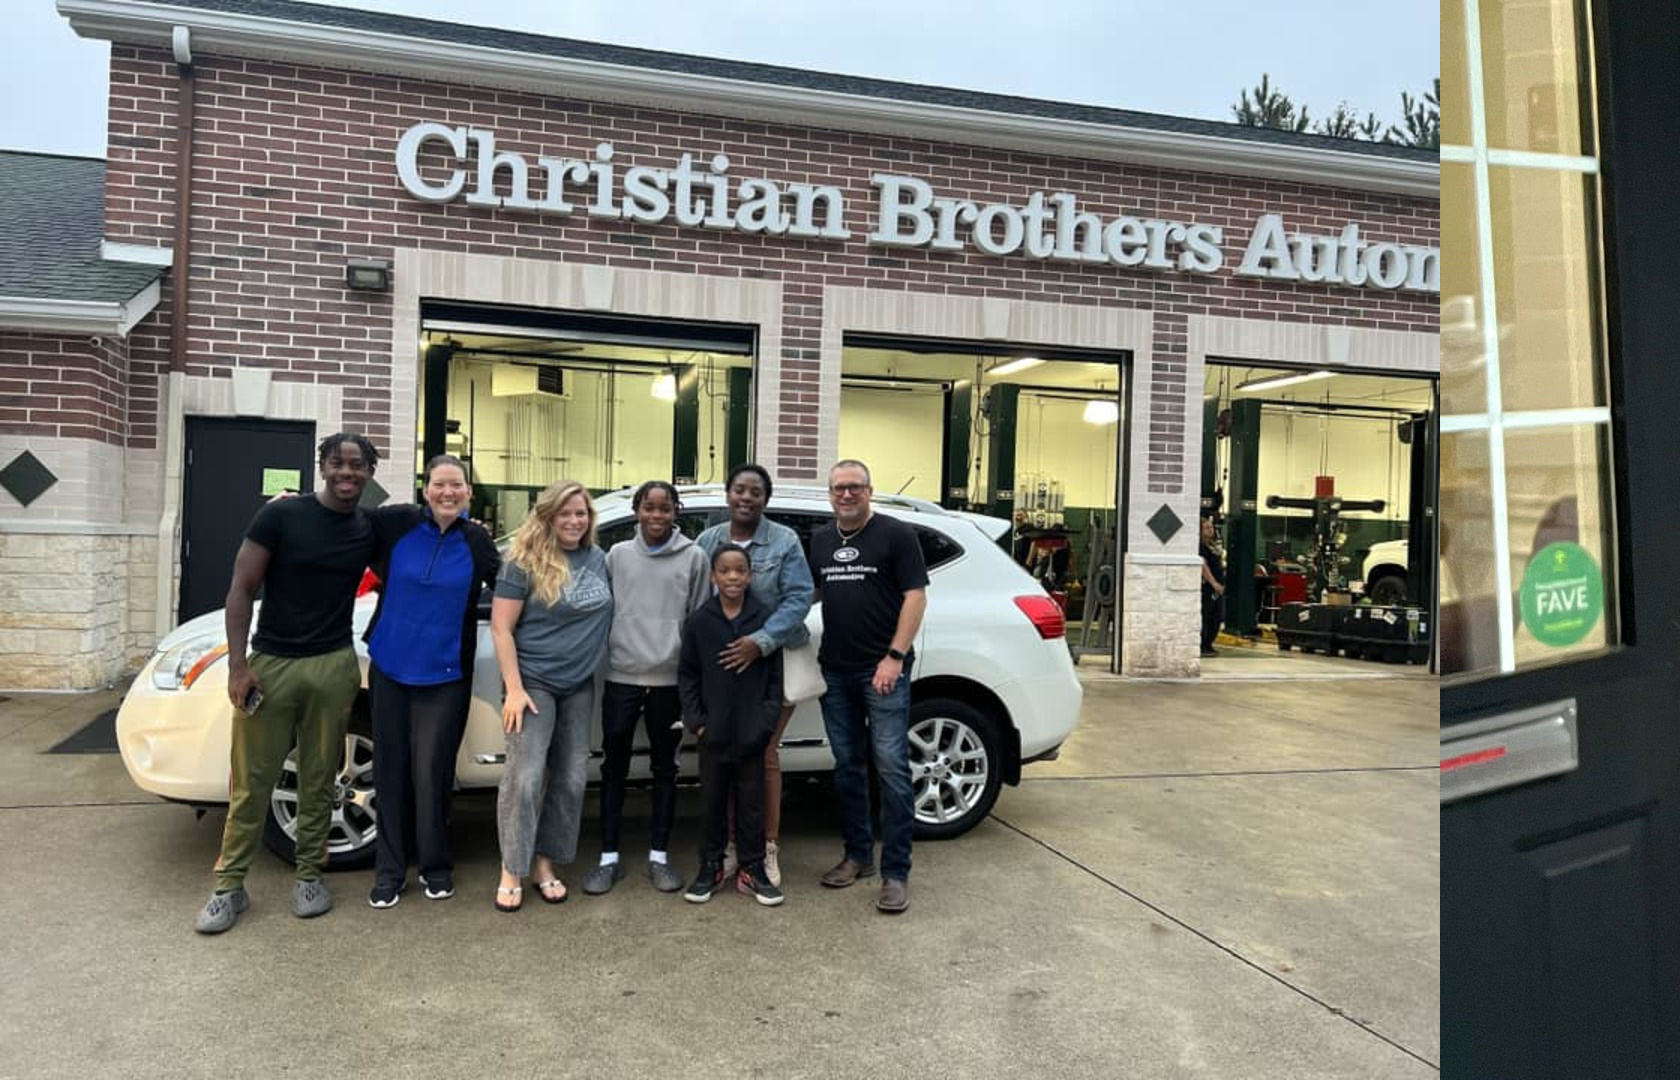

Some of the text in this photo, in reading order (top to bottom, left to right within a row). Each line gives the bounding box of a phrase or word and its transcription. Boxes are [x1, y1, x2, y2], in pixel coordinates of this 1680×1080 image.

[395, 122, 851, 239] Christian
[871, 172, 1223, 273] Brothers
[1537, 587, 1588, 616] FAVE
